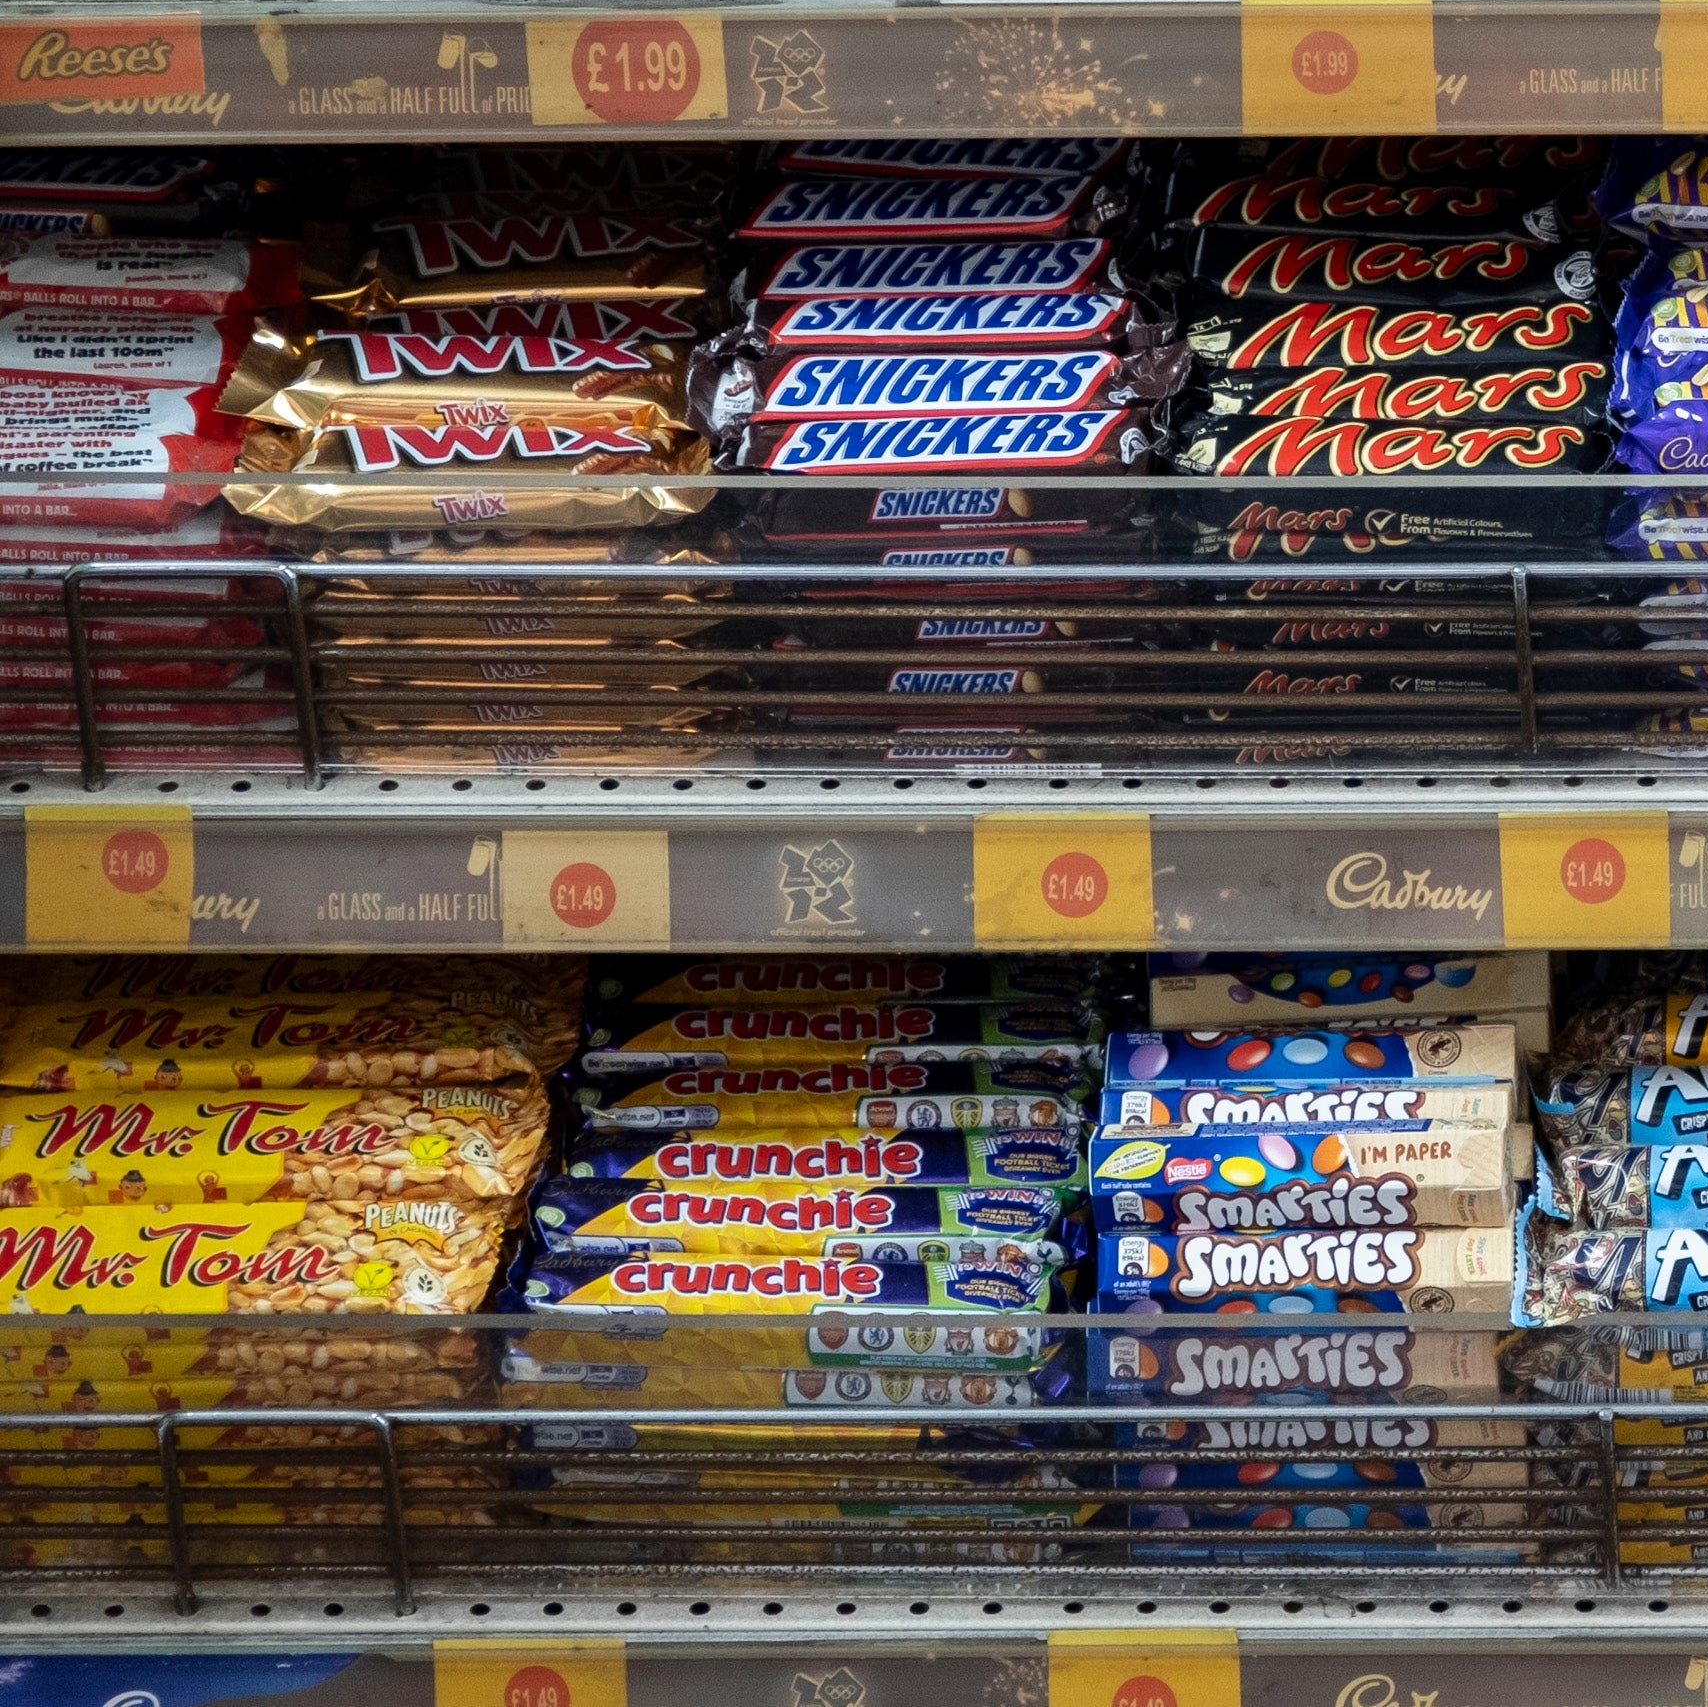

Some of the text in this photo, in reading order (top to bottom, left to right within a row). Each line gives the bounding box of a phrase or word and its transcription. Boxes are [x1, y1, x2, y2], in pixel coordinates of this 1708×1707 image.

[18, 32, 174, 81] Reese's
[586, 41, 686, 92] £1.99
[1301, 51, 1349, 79] £1.99
[1227, 302, 1594, 368] Mars
[776, 355, 1100, 405] SNICKERS
[876, 490, 1000, 516] SNICKERS
[1229, 503, 1351, 532] Mars
[108, 848, 155, 876] £1.49
[1567, 859, 1614, 887] £1.49
[555, 882, 603, 911] £1.49
[1048, 873, 1095, 901] £1.49
[1327, 851, 1492, 920] Cadbury
[28, 1101, 398, 1157] Mr. Tom
[656, 1140, 922, 1178] crunchie
[1360, 1142, 1451, 1164] I'M PAPER
[366, 1204, 459, 1231] PEANUTS
